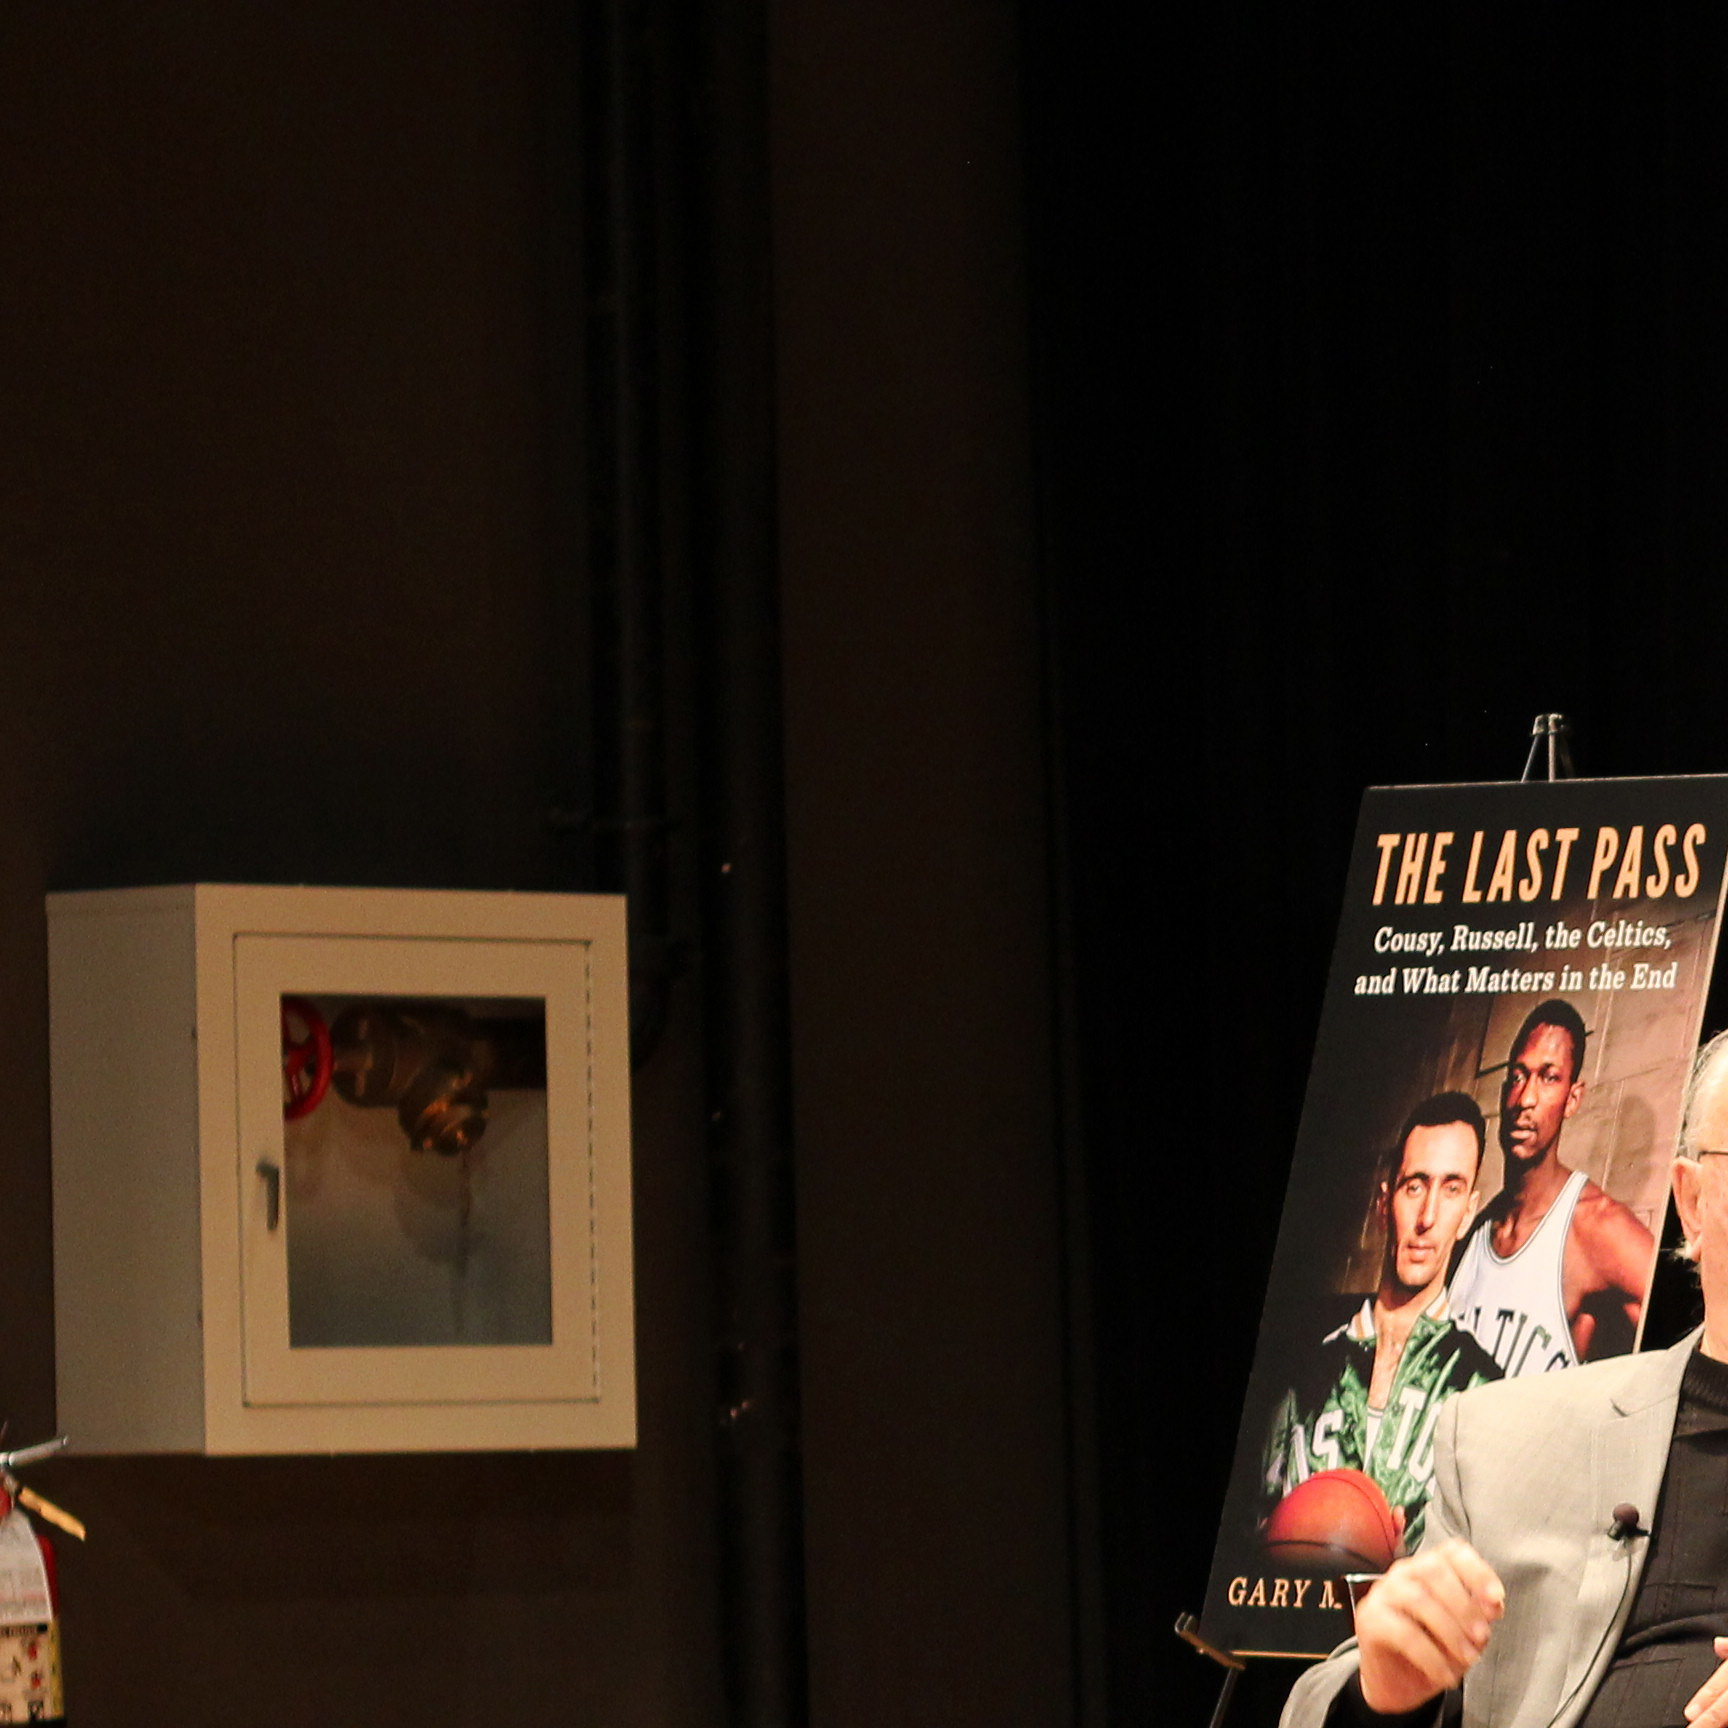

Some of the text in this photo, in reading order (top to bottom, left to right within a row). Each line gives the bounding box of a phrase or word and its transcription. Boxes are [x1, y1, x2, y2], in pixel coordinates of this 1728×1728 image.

[1372, 823, 1706, 905] THE LAST PASS
[1374, 920, 1671, 956] Cousy, Russell, the Celtics,
[1355, 962, 1678, 994] and What Matters in the End
[1228, 1577, 1312, 1606] GARY
